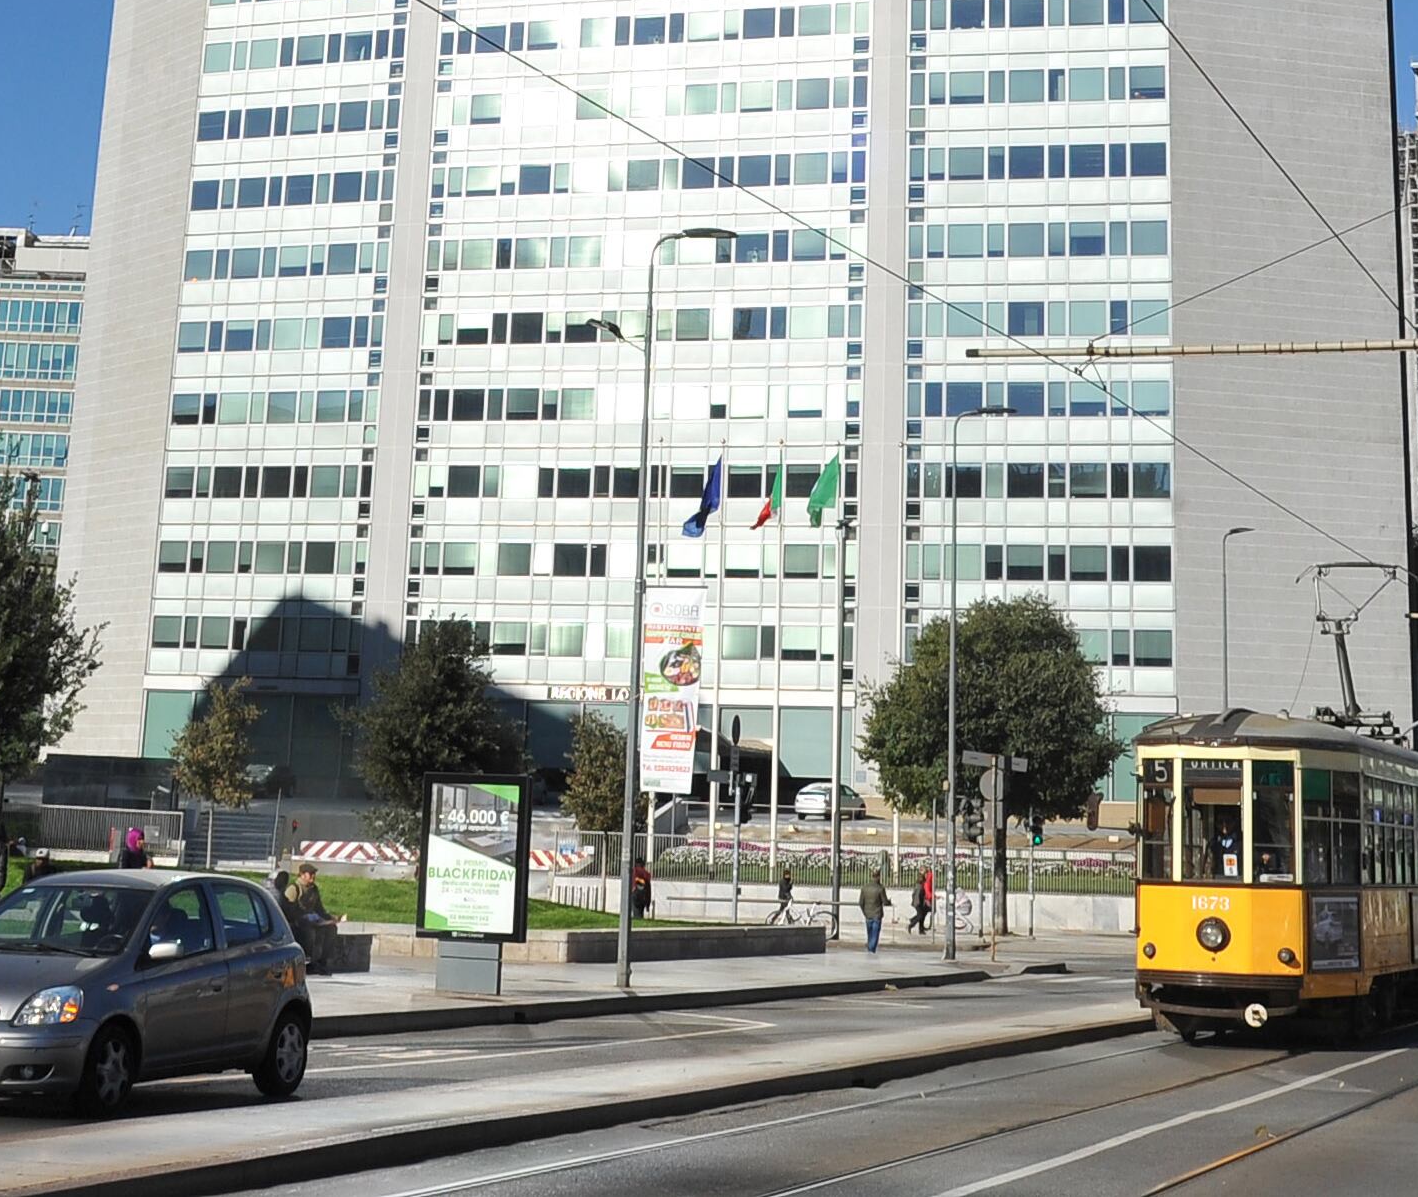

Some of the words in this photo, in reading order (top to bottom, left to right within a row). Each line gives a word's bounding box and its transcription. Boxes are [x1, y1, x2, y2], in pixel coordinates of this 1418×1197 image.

[666, 604, 699, 617] SOBA
[1154, 760, 1168, 782] 5
[447, 809, 497, 824] 46.000
[500, 810, 510, 824] €
[428, 867, 515, 882] BLACKFRIDAY
[1191, 894, 1231, 911] 1673
